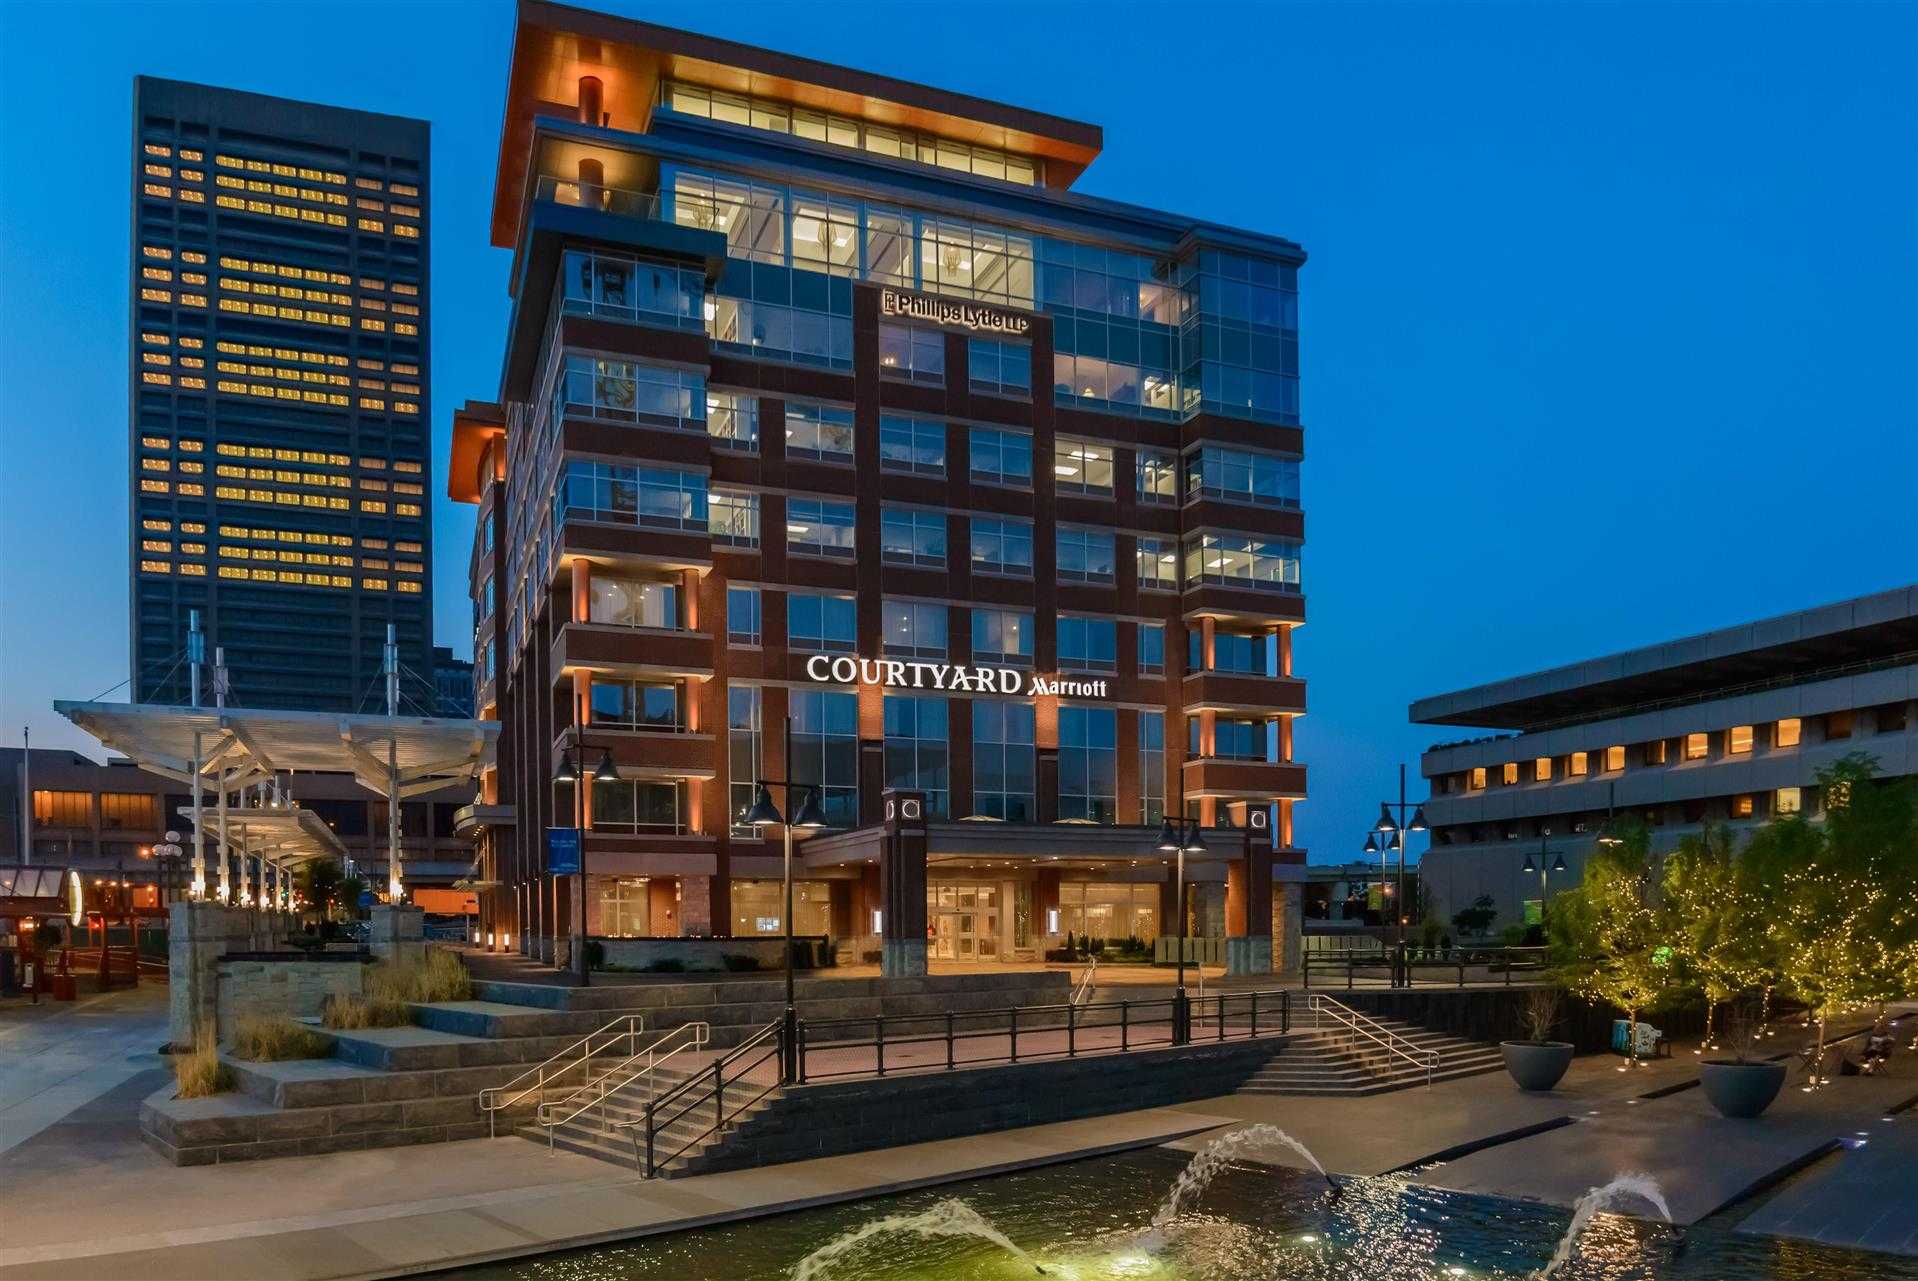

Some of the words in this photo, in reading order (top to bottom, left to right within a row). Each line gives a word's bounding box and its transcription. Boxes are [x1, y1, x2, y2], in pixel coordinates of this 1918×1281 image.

[897, 294, 961, 324] Phillips
[962, 305, 1002, 330] Lytle
[1004, 315, 1030, 333] LLP
[806, 655, 1022, 694] COURTYARD
[1027, 676, 1107, 697] Marriott
